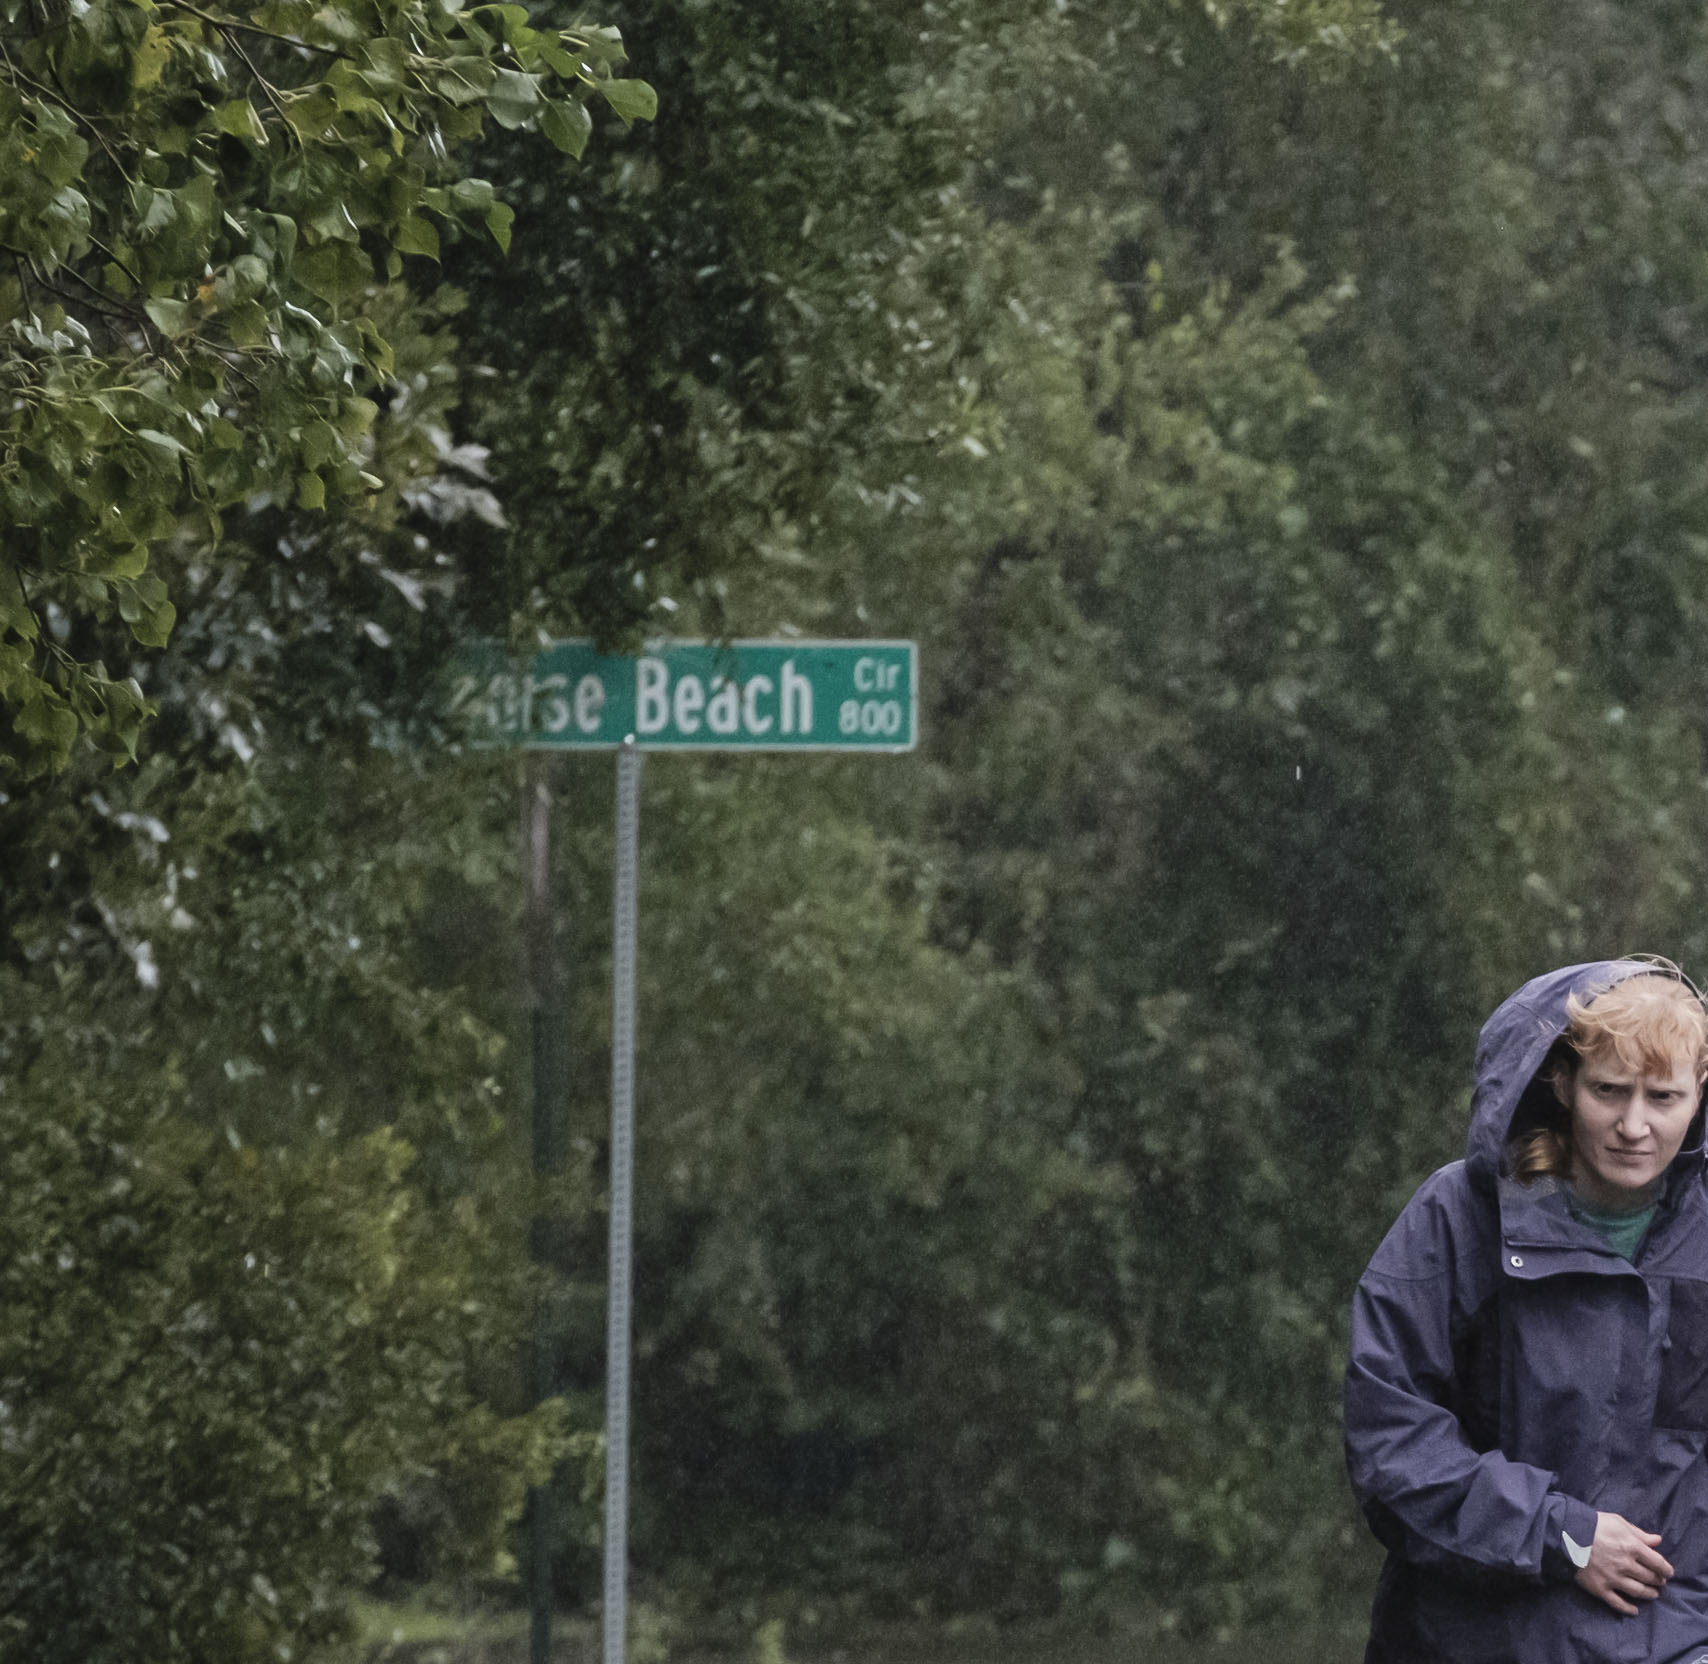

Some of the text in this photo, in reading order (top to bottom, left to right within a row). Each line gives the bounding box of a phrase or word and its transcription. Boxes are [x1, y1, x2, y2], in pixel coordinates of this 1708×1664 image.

[853, 657, 902, 692] Cir
[636, 657, 813, 734] Beach
[839, 699, 902, 735] 800
